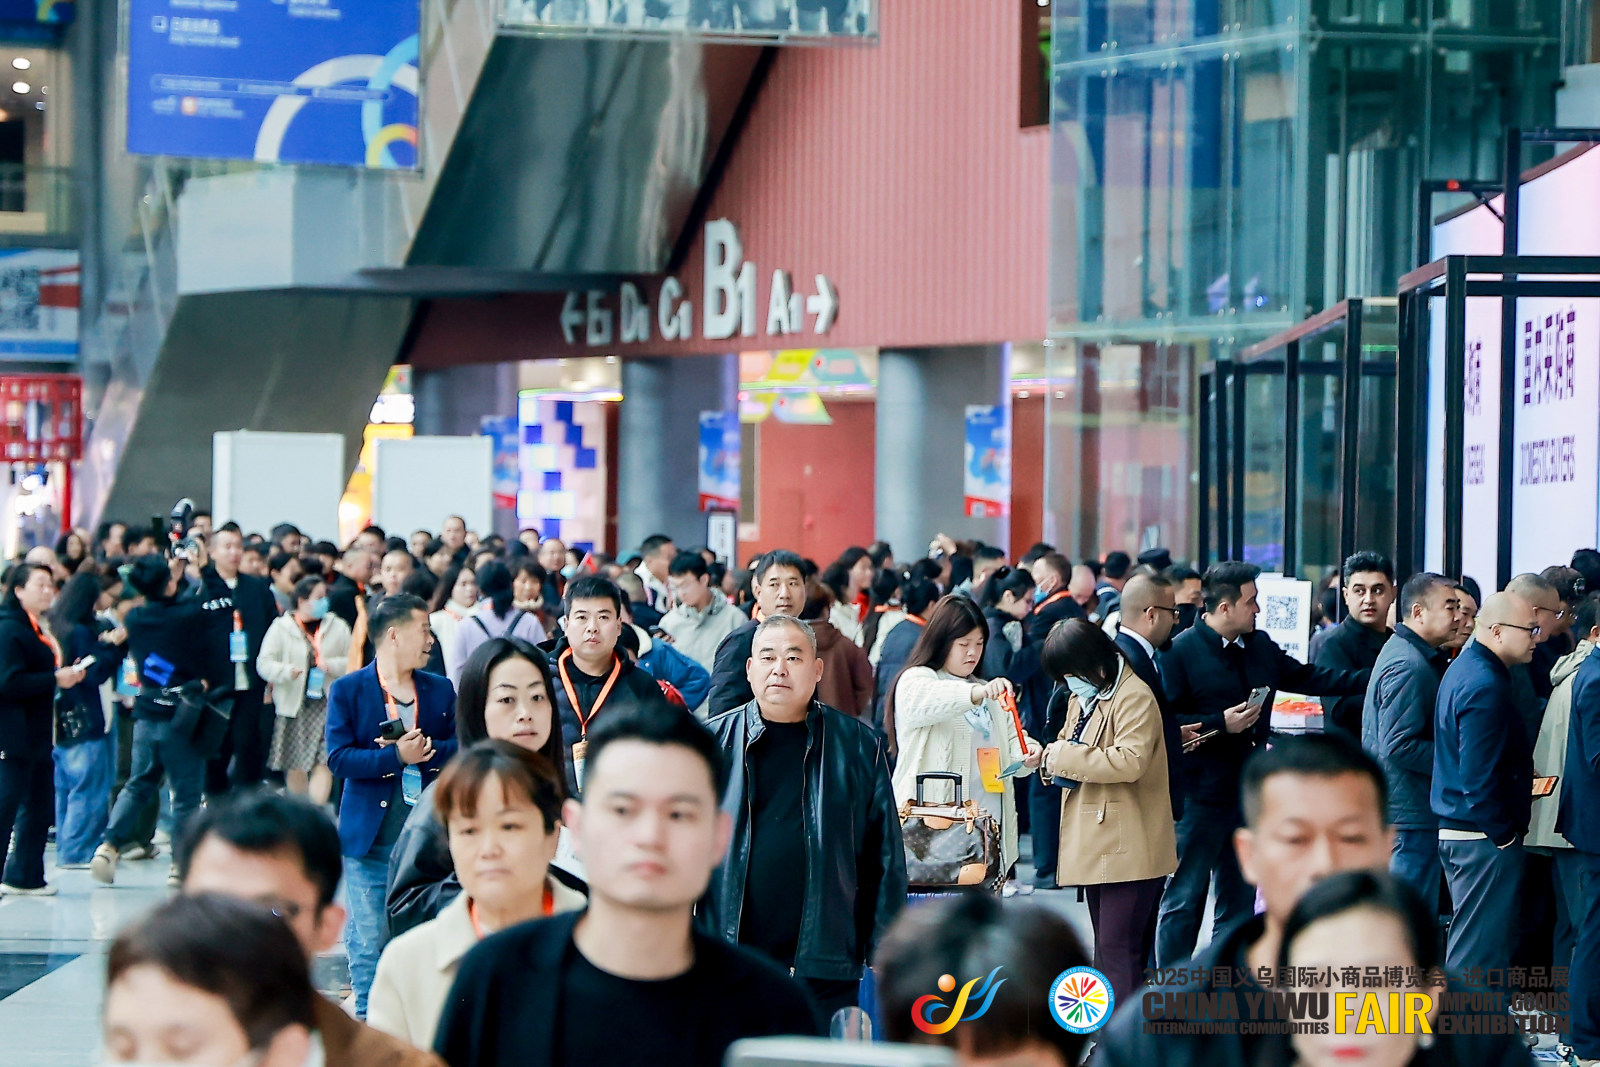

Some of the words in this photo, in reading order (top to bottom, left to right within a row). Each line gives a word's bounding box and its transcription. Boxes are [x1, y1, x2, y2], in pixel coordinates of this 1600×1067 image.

[620, 282, 649, 343] D1
[658, 276, 692, 340] C1
[703, 218, 756, 340] B1
[766, 269, 803, 335] A1
